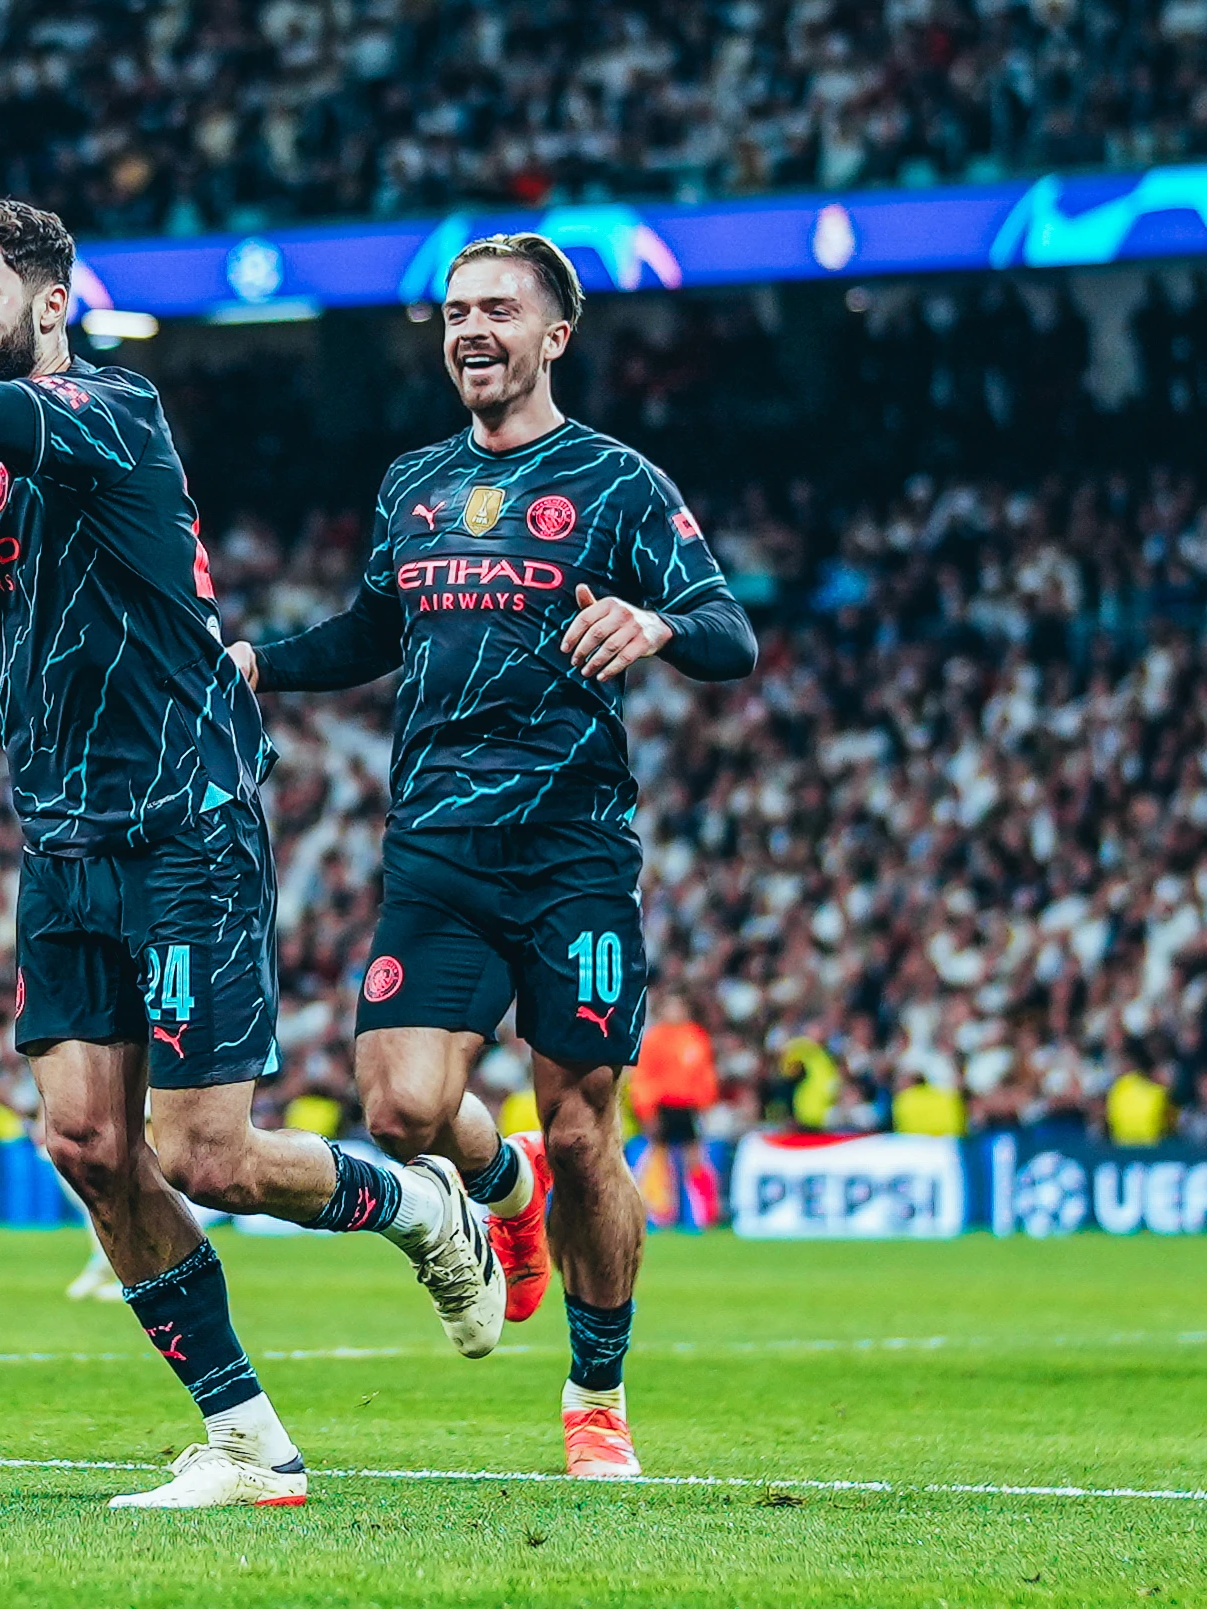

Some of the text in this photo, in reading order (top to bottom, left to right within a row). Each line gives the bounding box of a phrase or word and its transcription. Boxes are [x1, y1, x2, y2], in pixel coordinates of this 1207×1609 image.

[397, 559, 564, 590] ETIHAD
[419, 592, 526, 612] AIRWAYS
[142, 944, 195, 1021] 24
[567, 930, 623, 1004] 10
[757, 1171, 938, 1221] PEPSI
